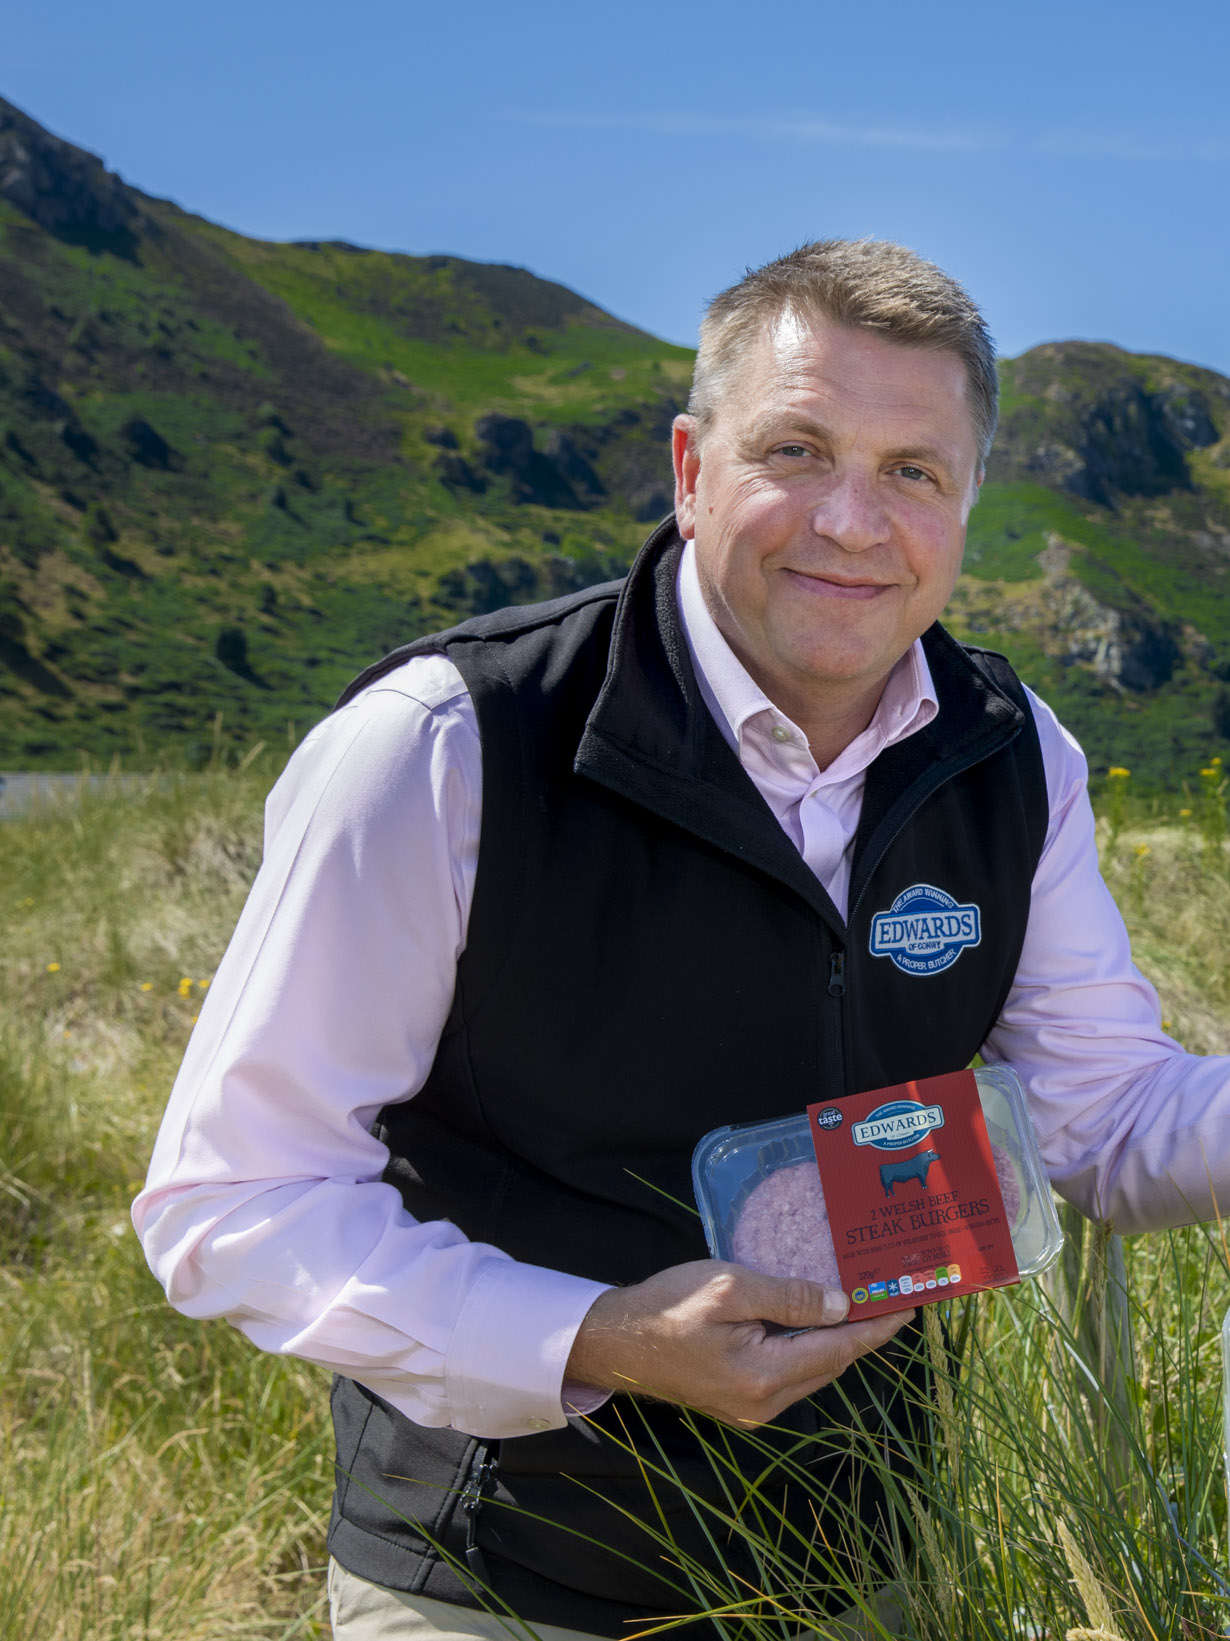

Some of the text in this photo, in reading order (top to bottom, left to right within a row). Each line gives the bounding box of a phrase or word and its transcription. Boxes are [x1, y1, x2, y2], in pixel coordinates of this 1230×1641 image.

[893, 888, 954, 913] THE AWARD WINNING
[879, 914, 972, 944] EDWARDS
[909, 941, 941, 951] OF CONWY
[897, 948, 957, 970] A PROPER BUTCHER
[819, 1113, 842, 1125] taste
[860, 1112, 936, 1138] EDWARDS
[871, 1191, 959, 1221] 2 WELSH BEEF
[846, 1218, 906, 1245] STEAK
[910, 1199, 990, 1230] BURGERS
